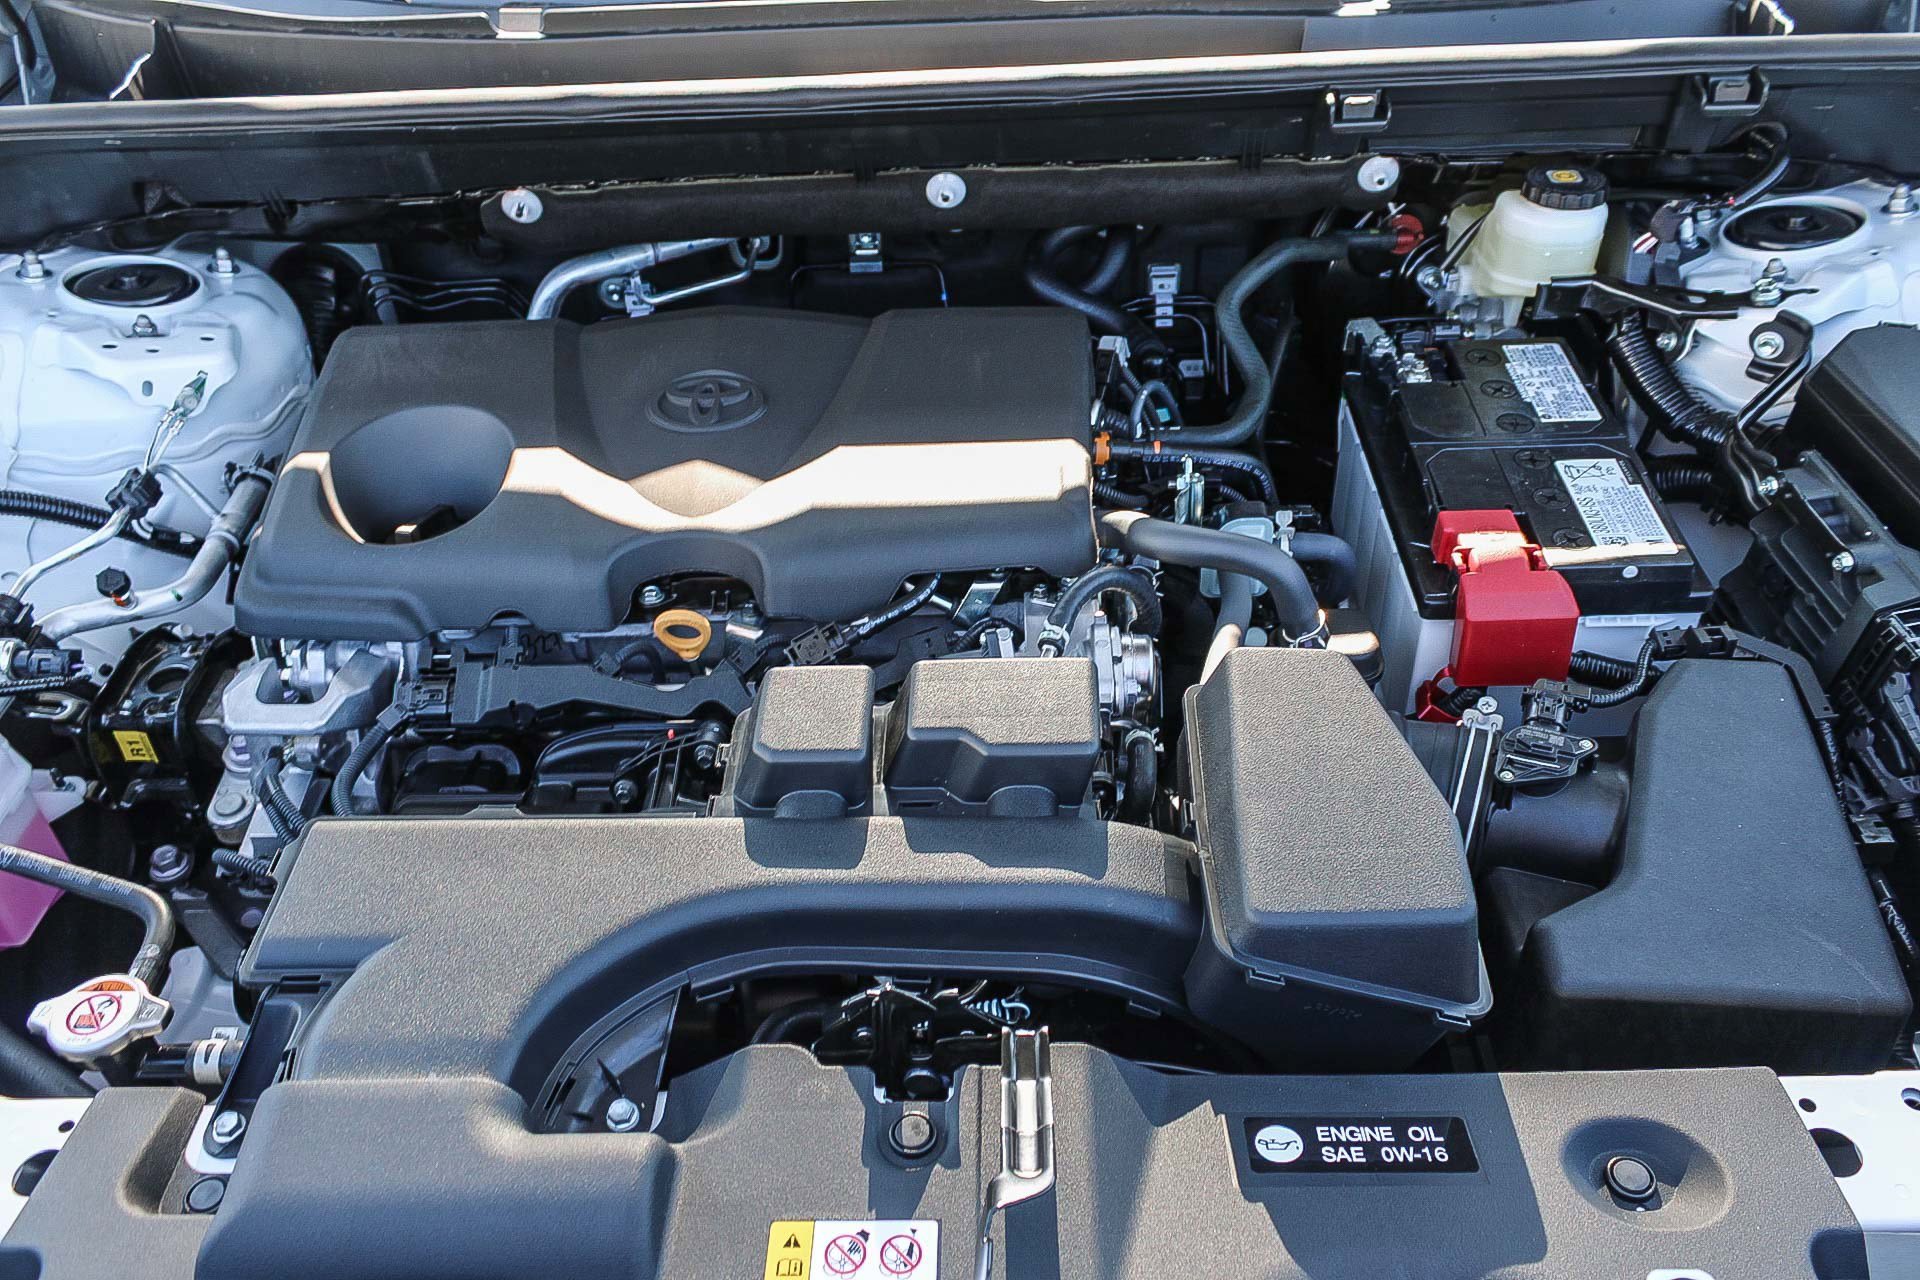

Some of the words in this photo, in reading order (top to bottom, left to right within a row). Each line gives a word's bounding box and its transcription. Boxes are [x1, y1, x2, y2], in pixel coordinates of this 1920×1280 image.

[1316, 1126, 1395, 1142] ENGINE
[1408, 1126, 1444, 1142] OIL
[1322, 1146, 1367, 1163] SAE
[1381, 1146, 1449, 1163] 0W-16
